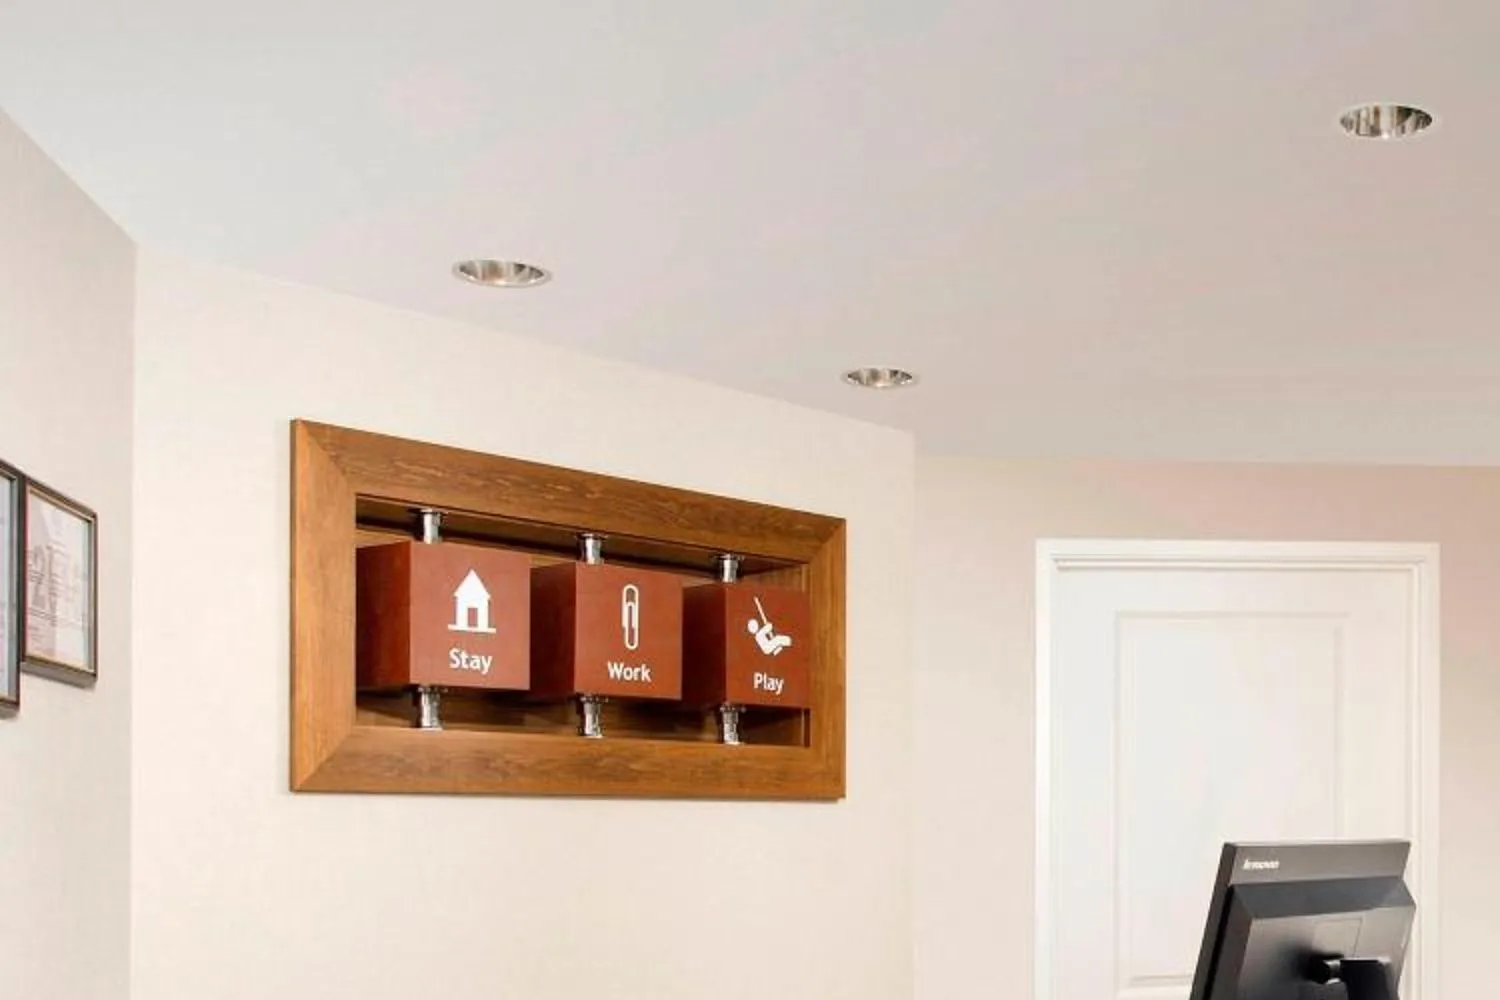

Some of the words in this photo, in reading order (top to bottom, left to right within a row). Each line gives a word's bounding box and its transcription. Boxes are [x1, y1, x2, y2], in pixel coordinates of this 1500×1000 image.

[449, 647, 493, 675] Stay
[607, 660, 652, 683] Work
[753, 672, 785, 695] Play
